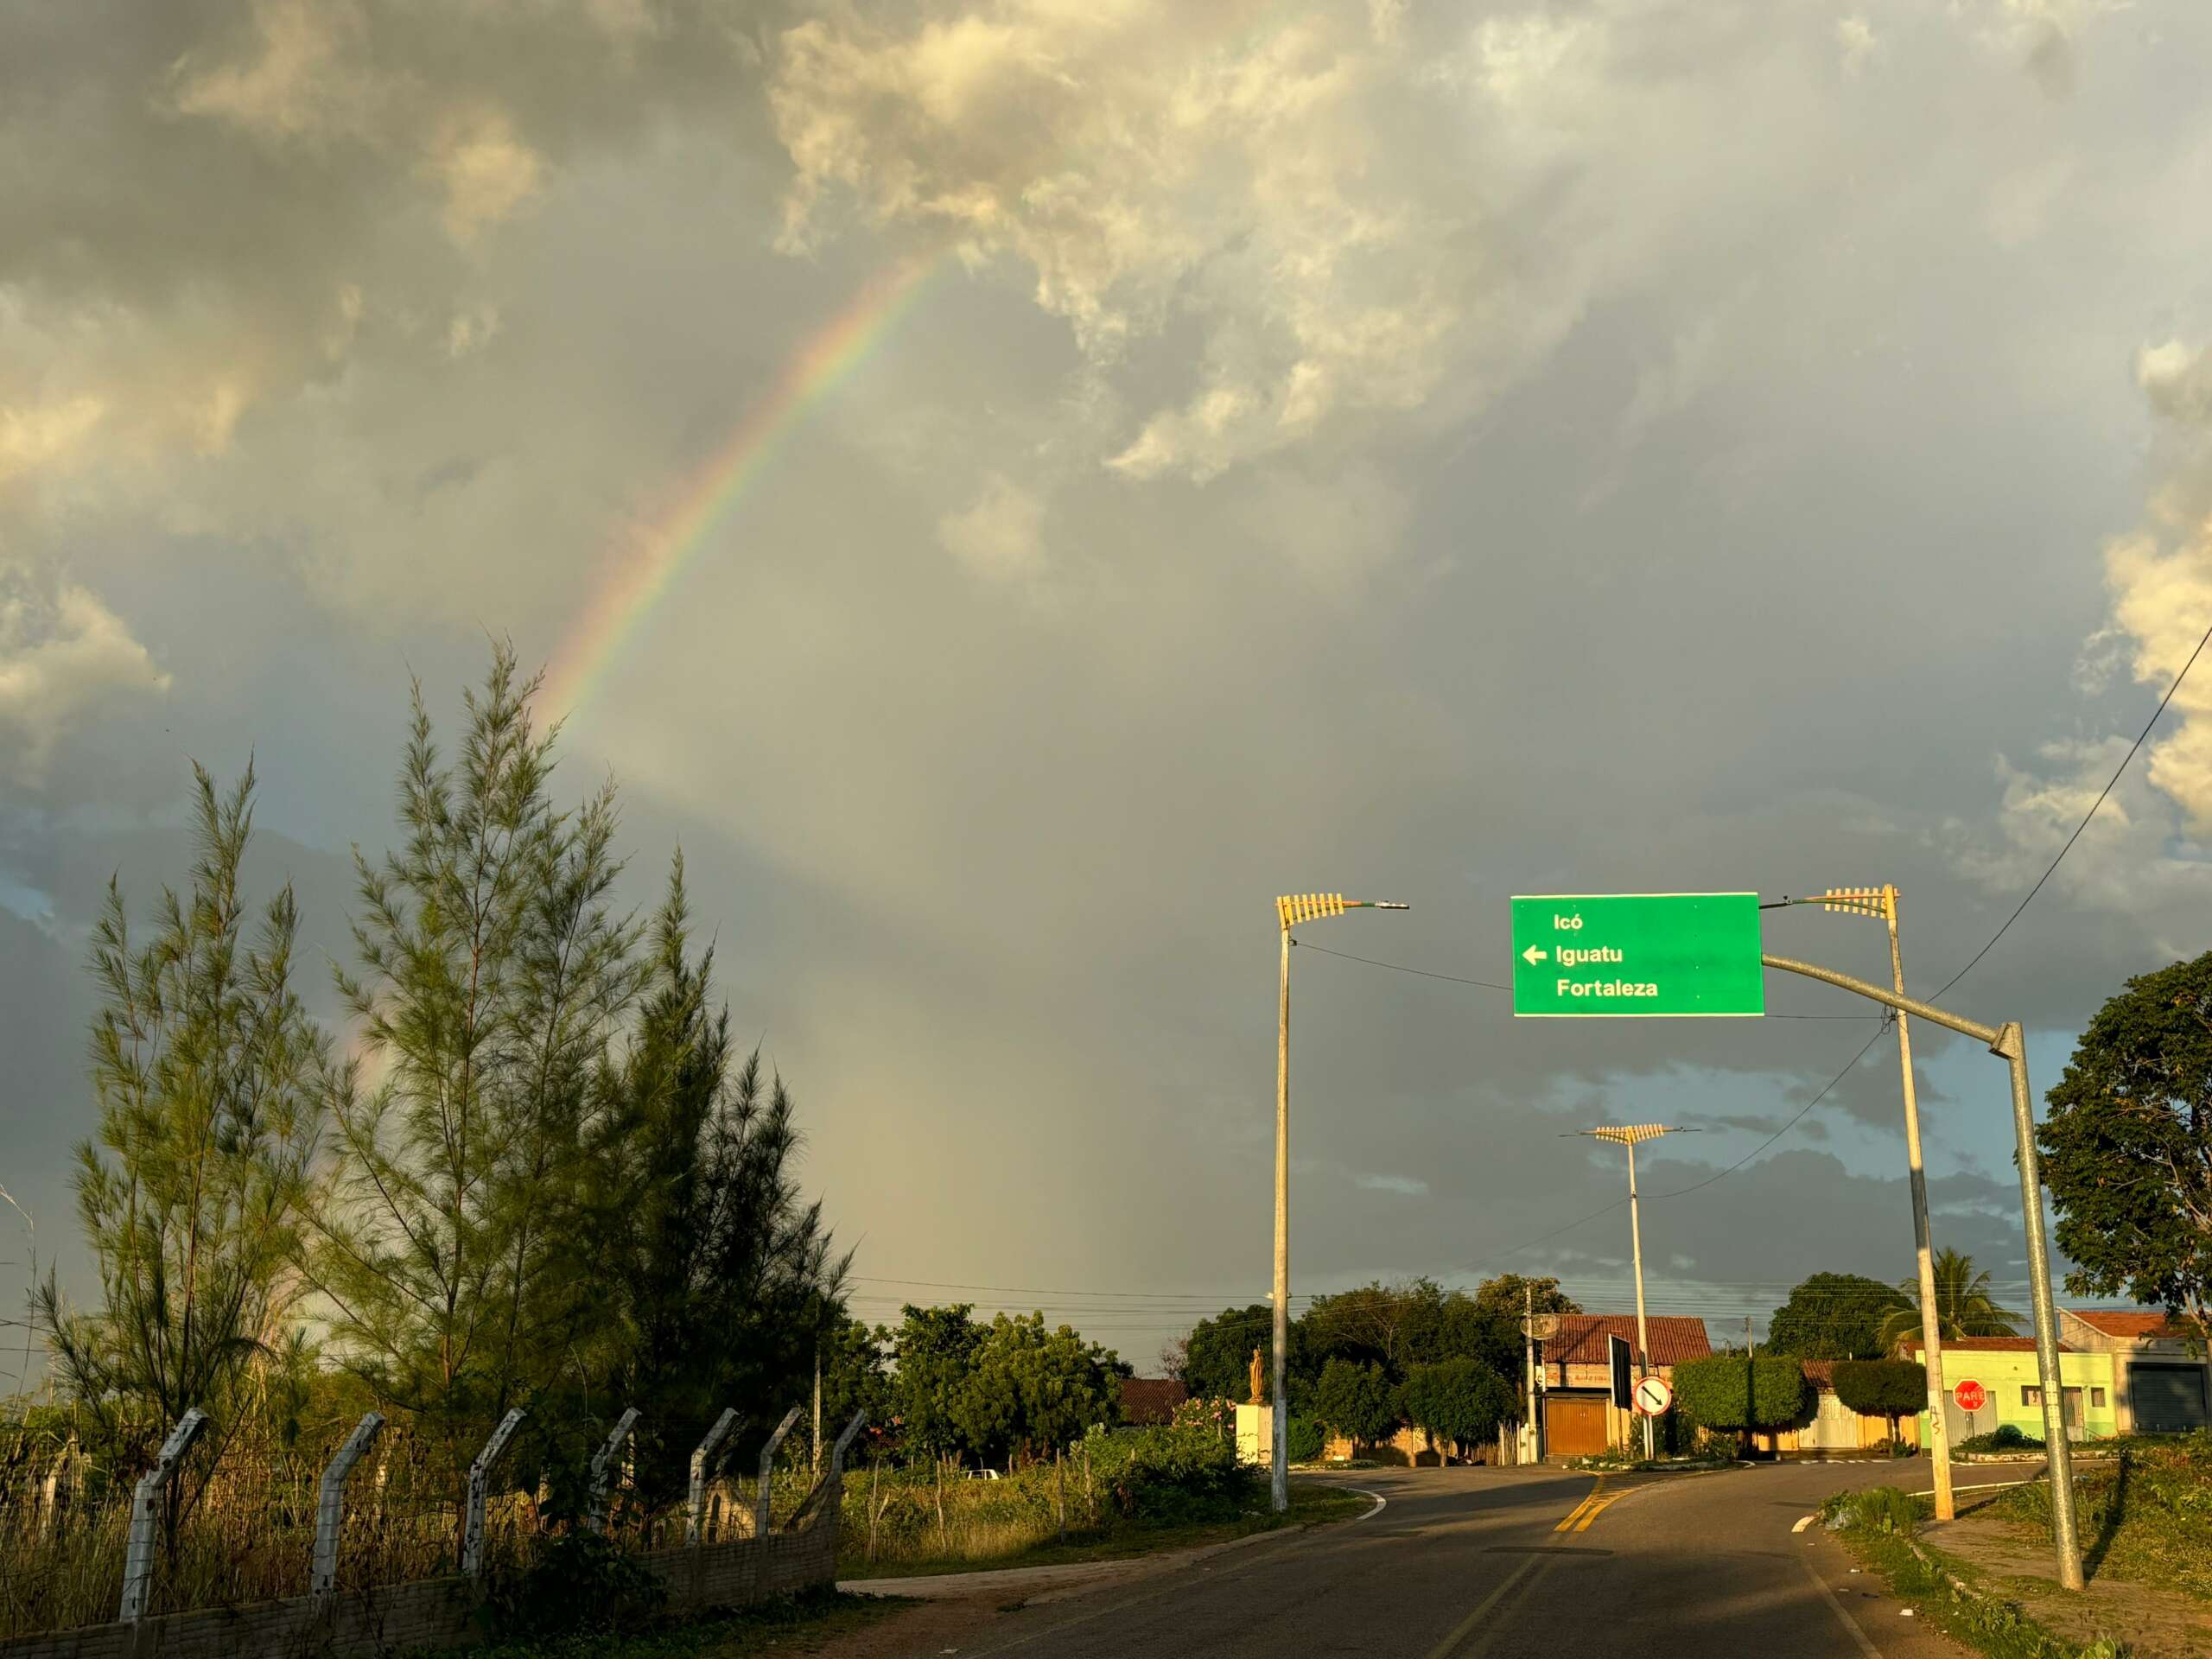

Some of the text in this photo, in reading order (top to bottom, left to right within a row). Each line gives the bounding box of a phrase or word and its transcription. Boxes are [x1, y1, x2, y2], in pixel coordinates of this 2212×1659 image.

[1554, 913, 1583, 930] Icó
[1556, 945, 1623, 967] Iguatu
[1557, 979, 1658, 996] Fortaleza
[1955, 1391, 1985, 1401] PARE
